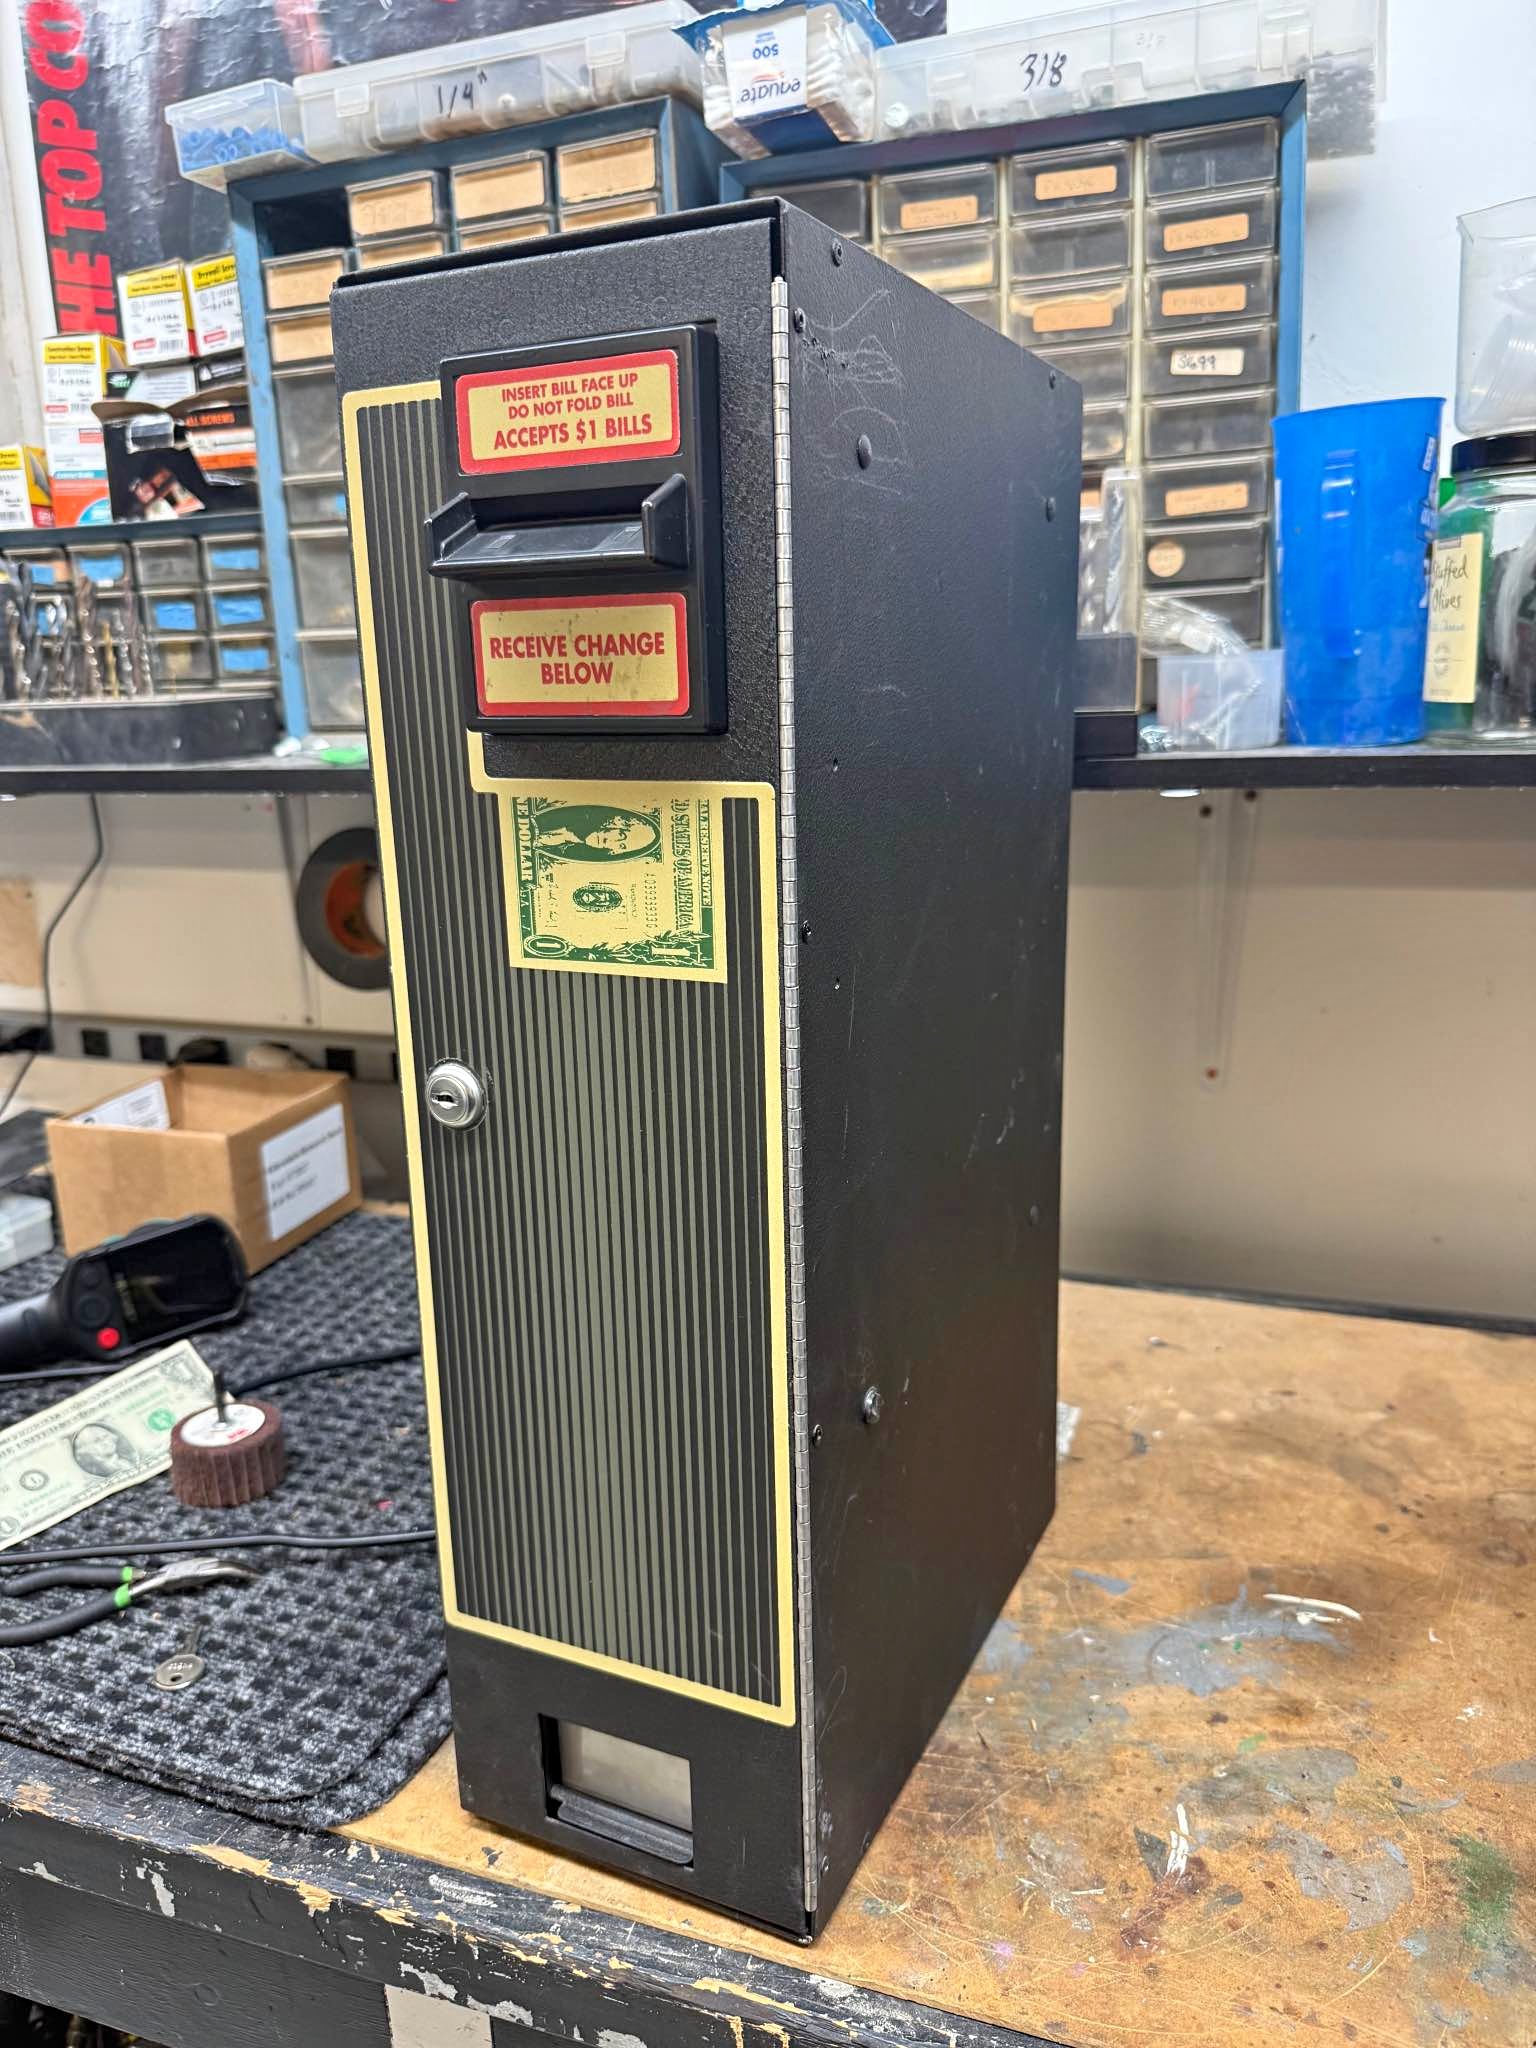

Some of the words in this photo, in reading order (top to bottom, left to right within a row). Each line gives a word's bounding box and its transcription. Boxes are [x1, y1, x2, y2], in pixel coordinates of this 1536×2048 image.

[752, 43, 779, 60] 500
[1020, 51, 1067, 91] 3/8
[740, 78, 801, 104] equate
[36, 99, 108, 236] TOP
[502, 384, 547, 403] INSERT
[551, 380, 578, 397] BILL
[582, 376, 614, 393] FACE
[618, 373, 639, 389] UP
[508, 404, 530, 420] DO
[533, 400, 562, 417] NOT
[567, 396, 602, 413] FOLD
[606, 392, 634, 407] BILL
[494, 422, 570, 450] ACCEPTS
[576, 418, 597, 444] $1
[605, 413, 653, 439] BILLS
[489, 635, 568, 659] RECEIVE
[574, 632, 665, 657] CHANGE
[541, 661, 614, 685] BELOW
[518, 817, 533, 880] DOLLAR
[672, 814, 692, 857] STATES
[700, 821, 713, 875] RESERVE
[673, 858, 693, 874] OF
[701, 876, 713, 906] NOTE
